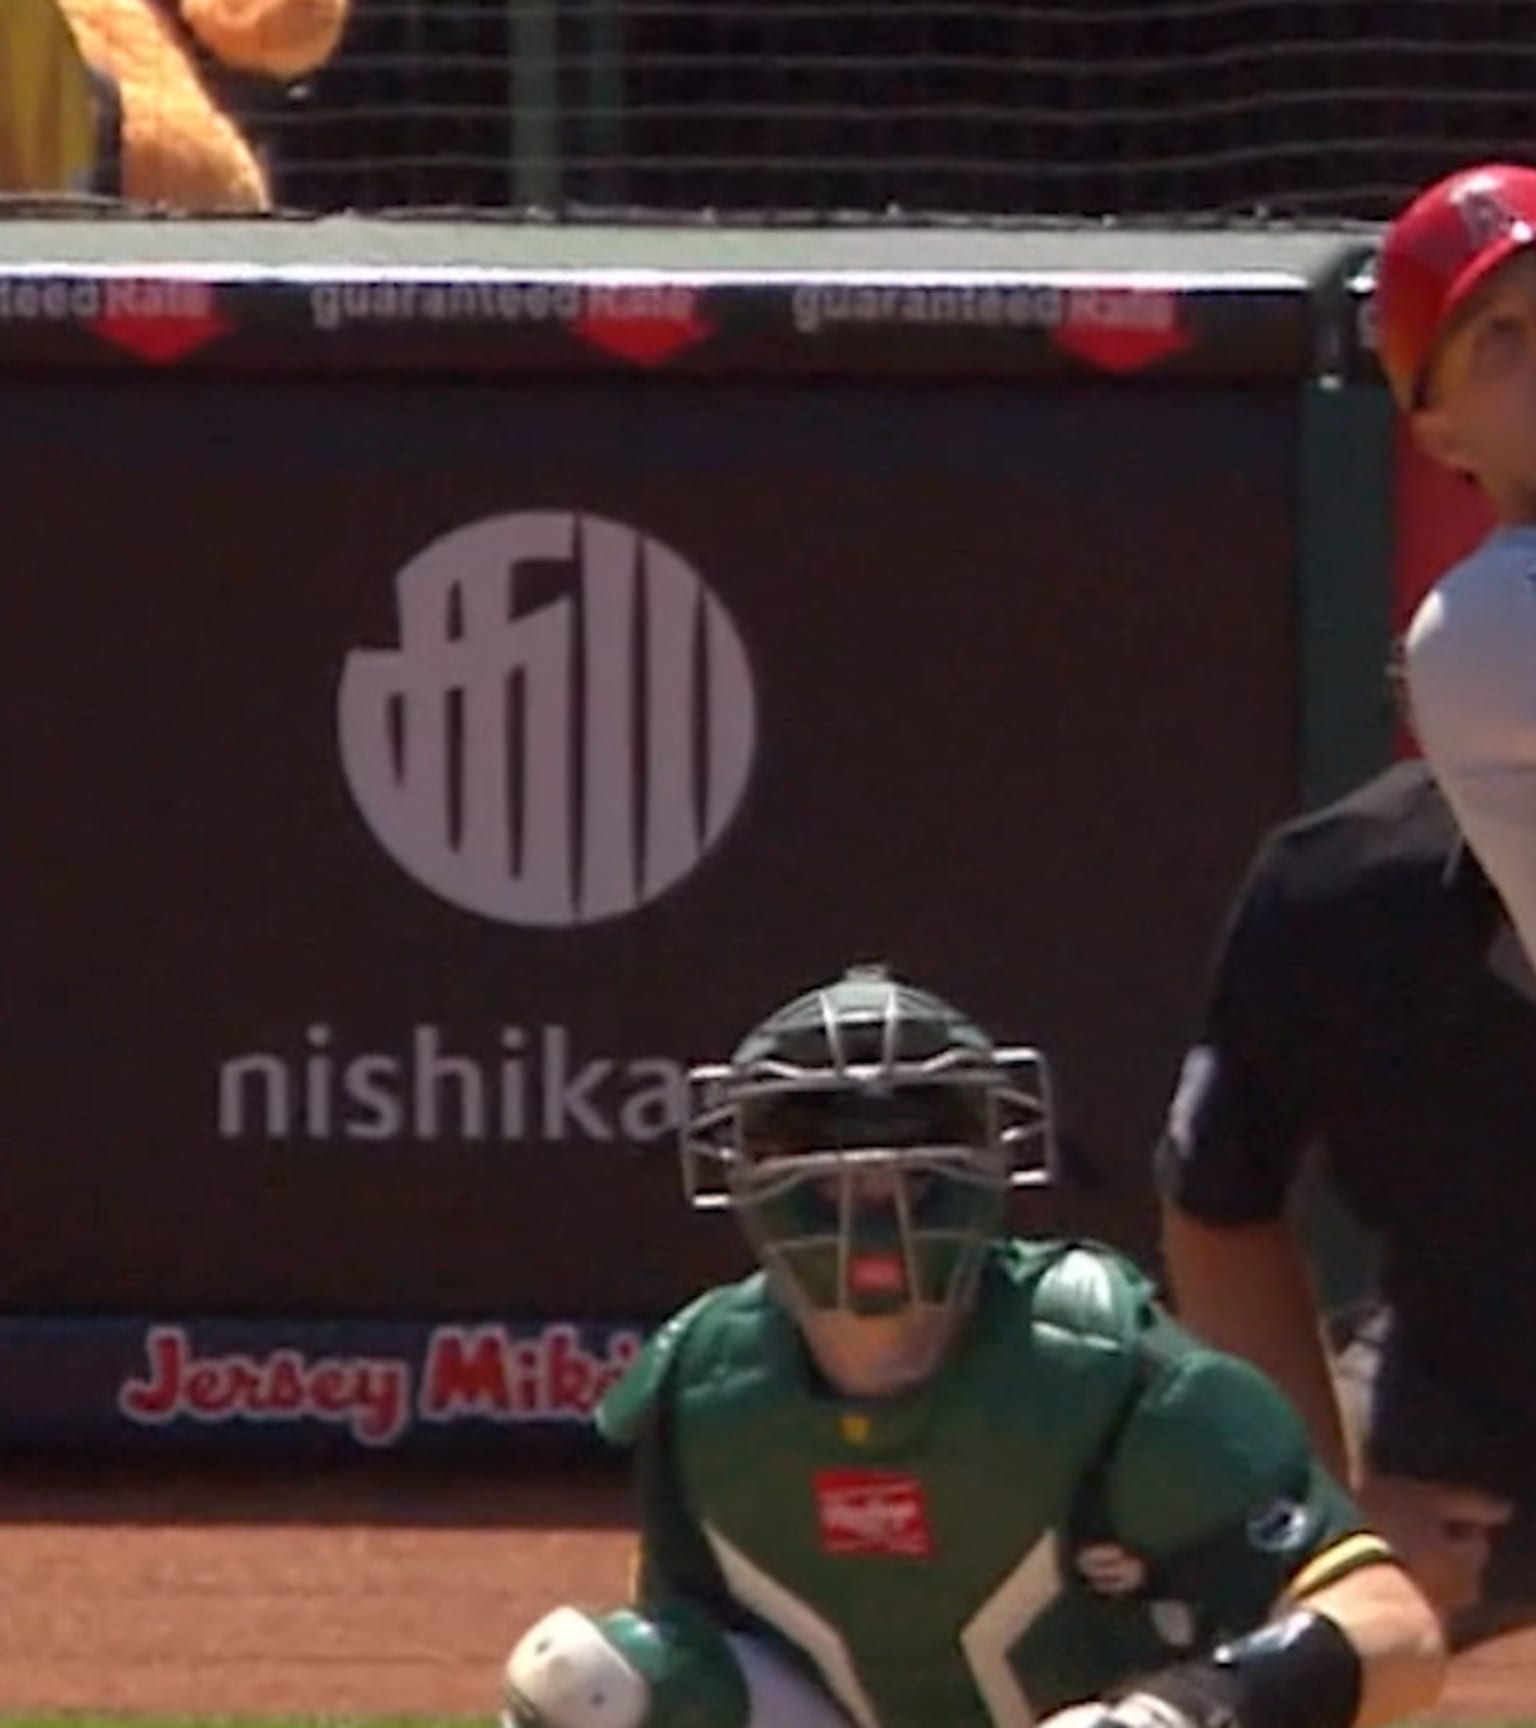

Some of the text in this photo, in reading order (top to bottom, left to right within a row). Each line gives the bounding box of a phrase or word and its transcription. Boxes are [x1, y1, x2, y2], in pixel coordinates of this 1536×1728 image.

[309, 283, 578, 330] guaranteed
[792, 285, 1062, 331] guaranteed
[120, 1324, 408, 1446] Jersey
